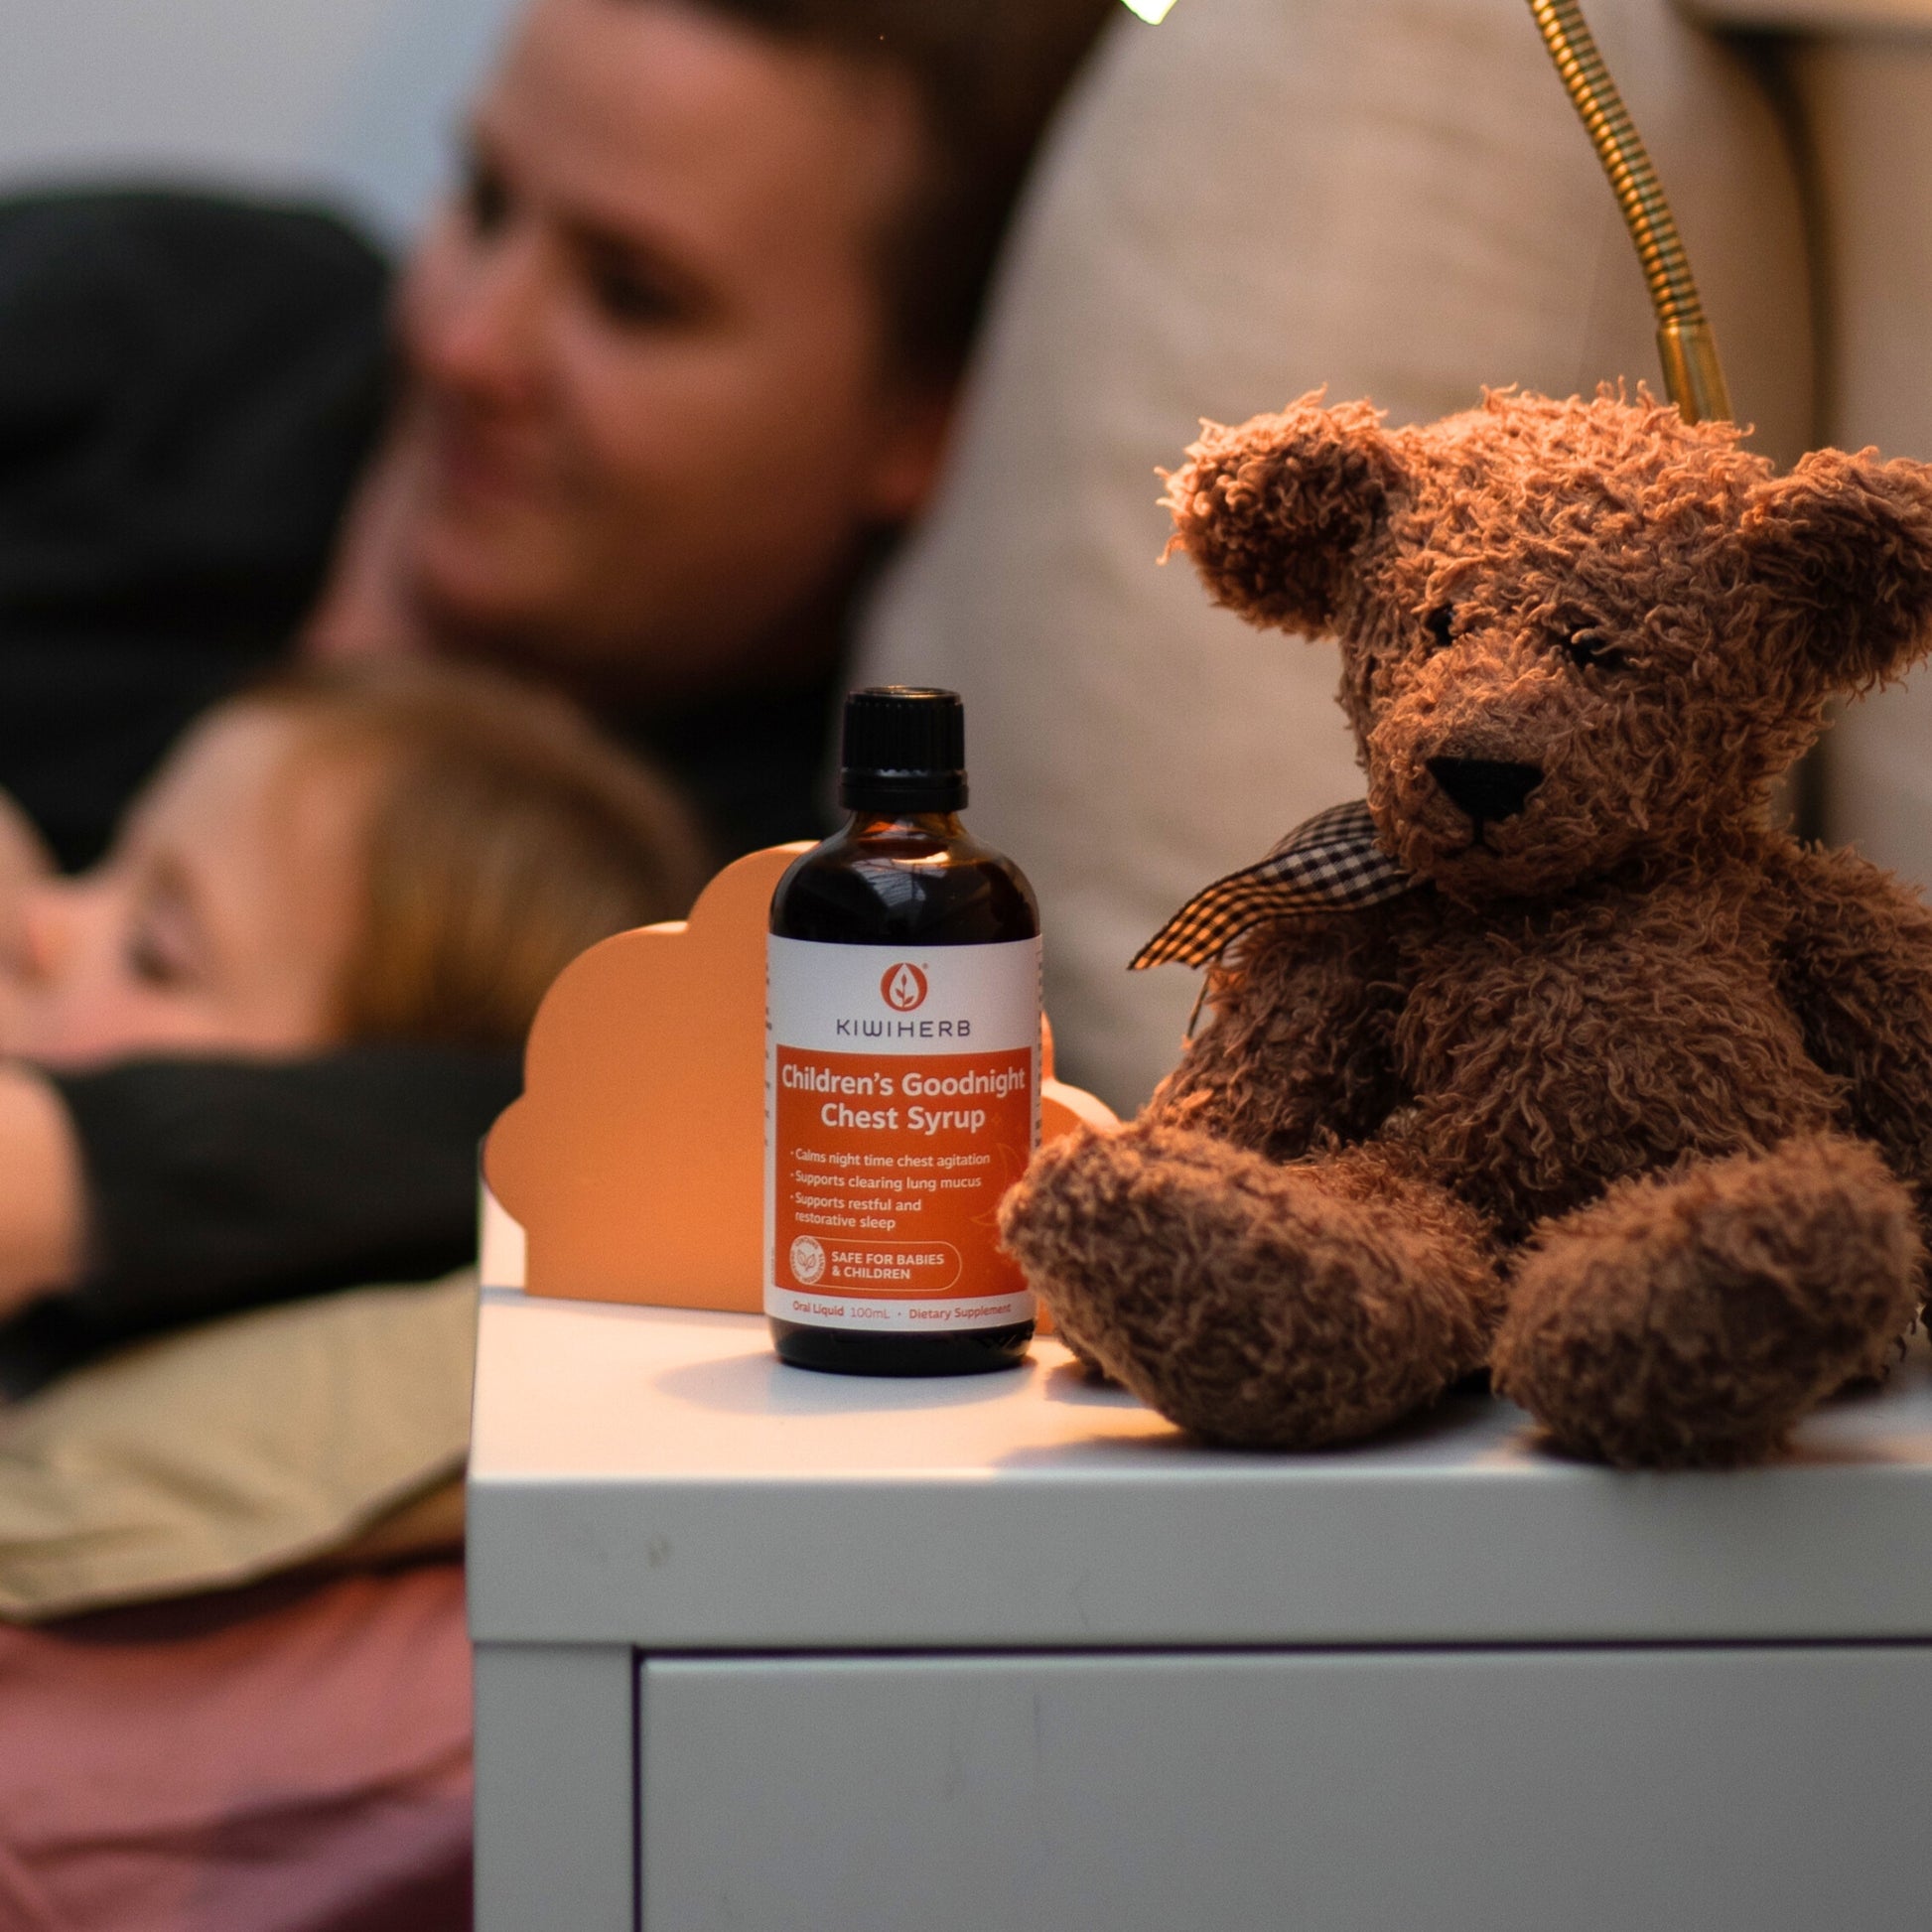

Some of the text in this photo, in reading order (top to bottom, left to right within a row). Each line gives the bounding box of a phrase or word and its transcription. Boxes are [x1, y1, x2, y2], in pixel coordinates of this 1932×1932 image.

[836, 1019, 971, 1037] KIWIHERB
[901, 1066, 1026, 1098] Goodnight
[821, 1102, 986, 1136] Chest Syrup
[795, 1148, 991, 1169] Calms night time chest agitation
[795, 1170, 982, 1191] Supports clearing lung mucus
[795, 1191, 921, 1211] Supports restful and
[795, 1211, 896, 1230] restorative sleep
[831, 1251, 944, 1265] SAFE FOR BABIES
[832, 1266, 910, 1280] & CHILDREN
[793, 1301, 1012, 1320] Oral Liquid 100mL Dietary Supplement
